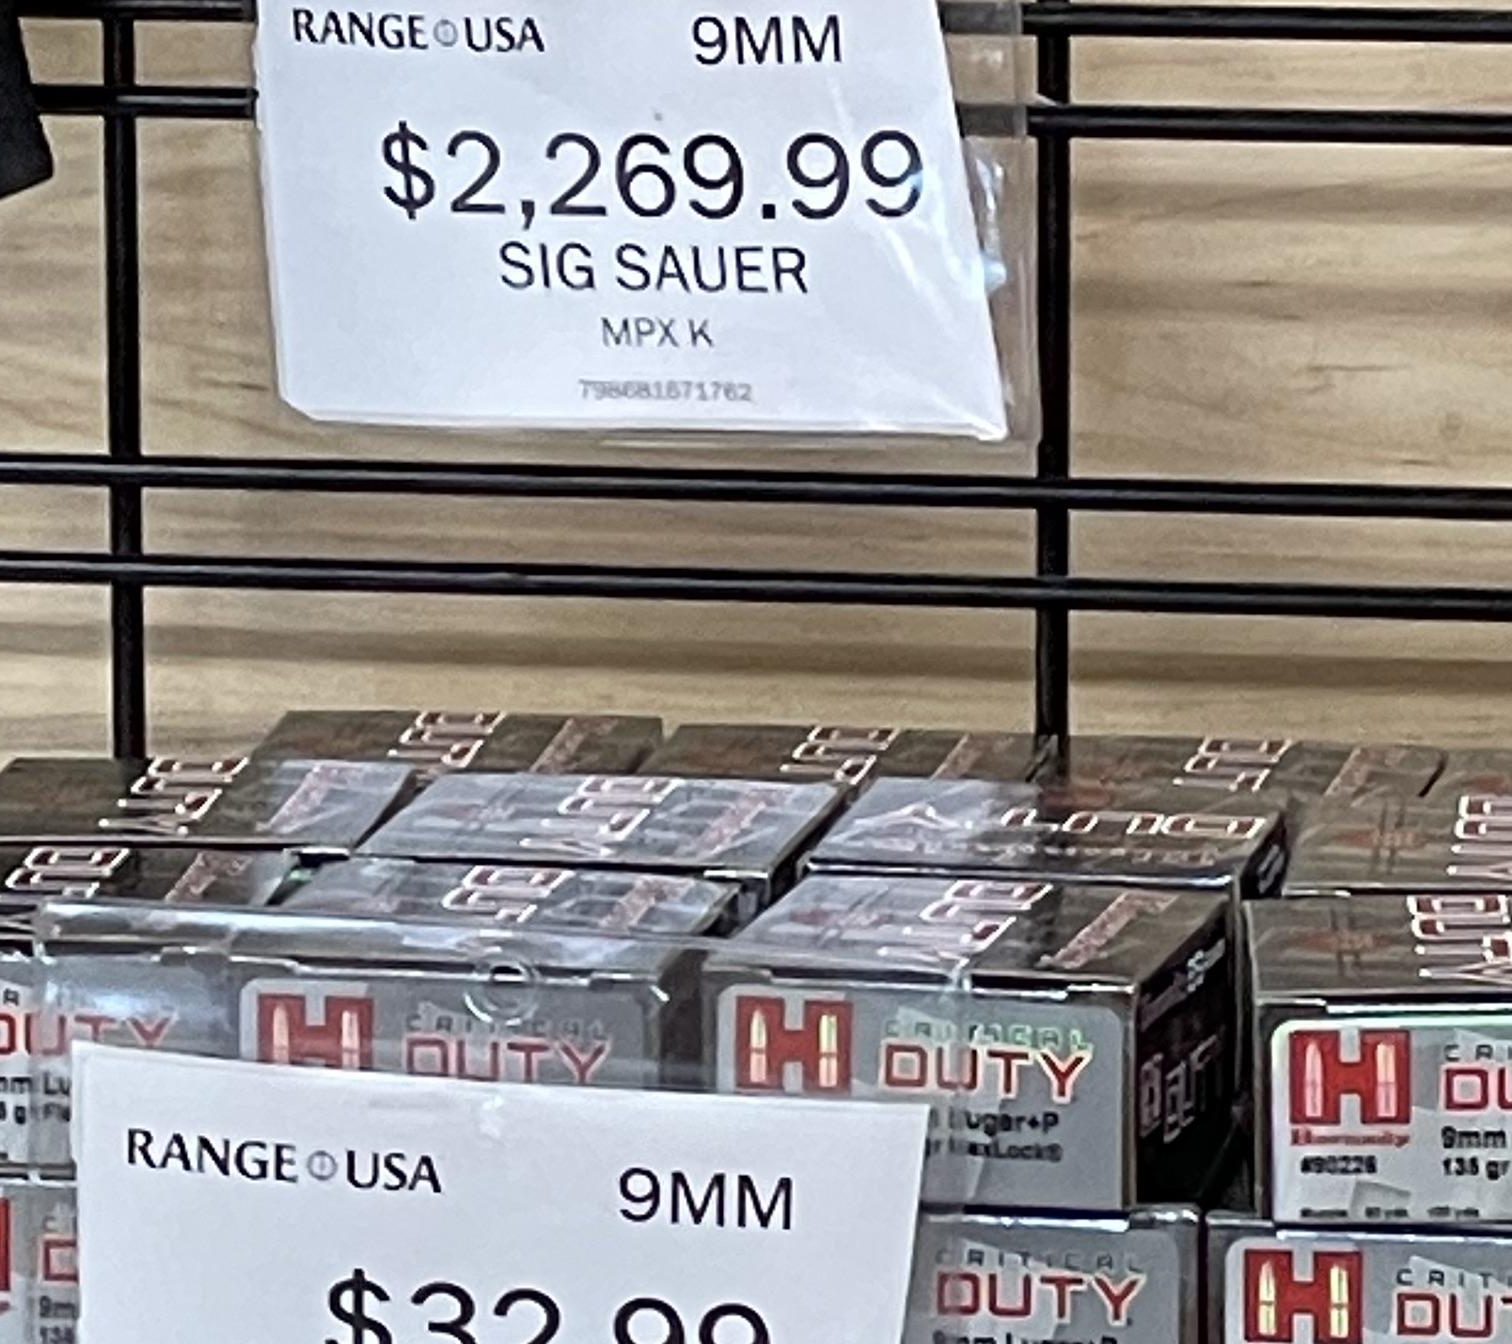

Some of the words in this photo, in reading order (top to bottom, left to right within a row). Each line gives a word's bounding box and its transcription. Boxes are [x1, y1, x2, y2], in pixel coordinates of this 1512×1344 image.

[292, 8, 428, 50] RANGE
[464, 16, 545, 53] USA
[692, 14, 842, 65] 9MM
[382, 121, 923, 230] $2,269.99
[499, 240, 596, 290] SIG
[615, 242, 808, 293] SAUER
[601, 317, 678, 347] MPX
[688, 319, 714, 347] K
[406, 1038, 612, 1083] DUTY
[885, 1043, 1092, 1098] DUTY
[127, 1128, 298, 1184] RANGE
[346, 1150, 442, 1194] USA
[1441, 1126, 1507, 1149] 9mm
[618, 1167, 793, 1231] 9MM
[937, 1272, 1145, 1321] DUTY
[1396, 1292, 1512, 1338] DU
